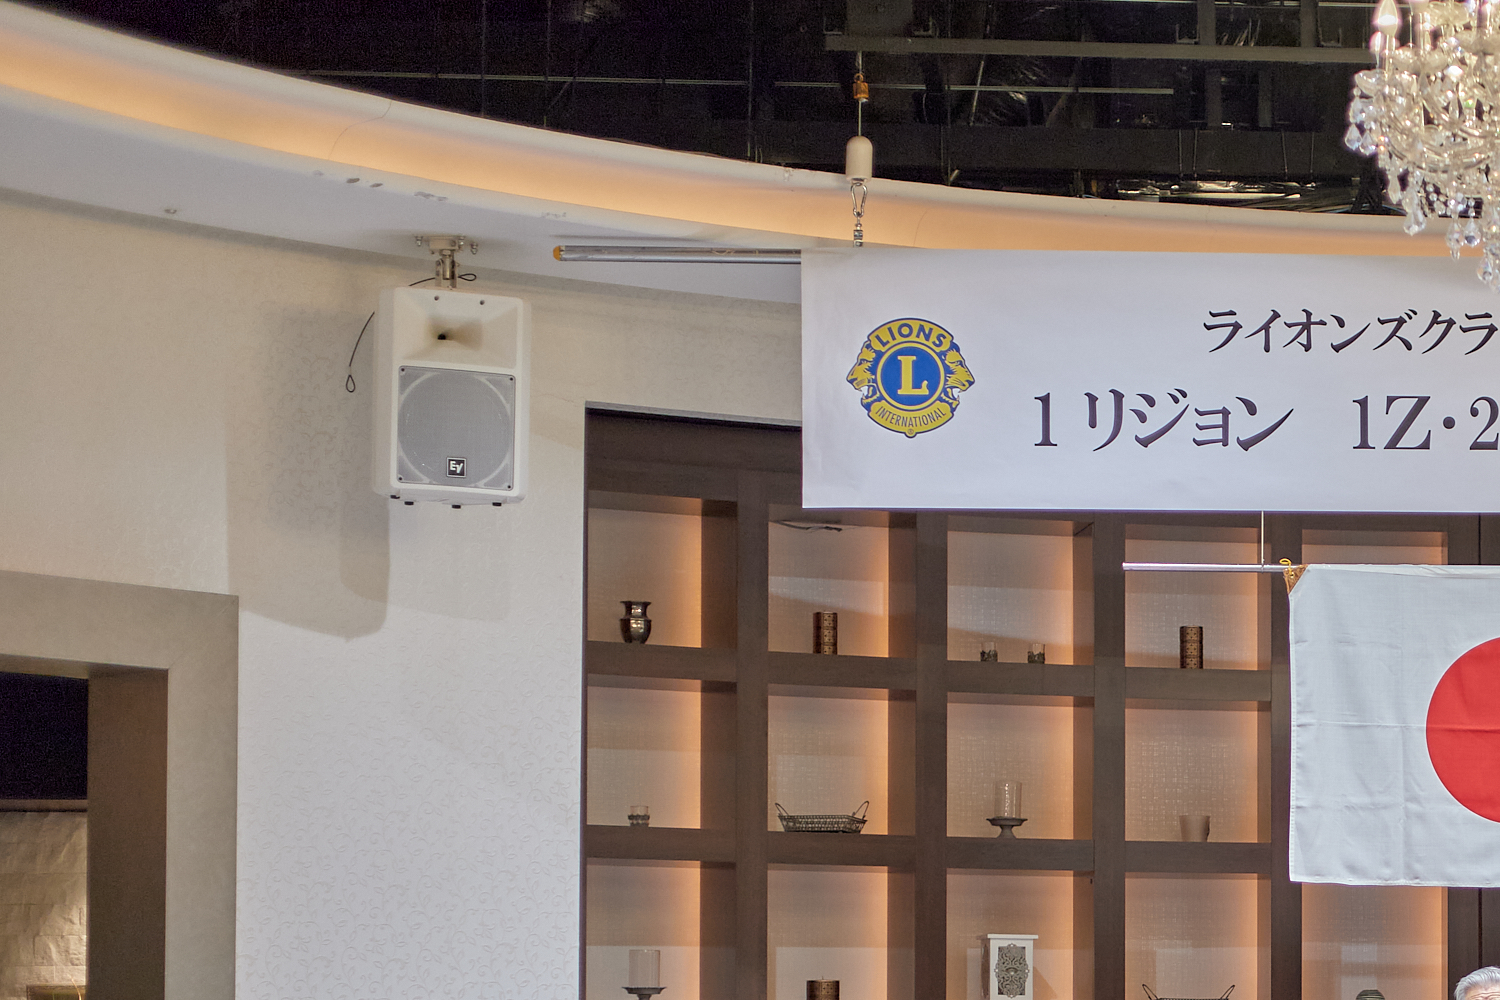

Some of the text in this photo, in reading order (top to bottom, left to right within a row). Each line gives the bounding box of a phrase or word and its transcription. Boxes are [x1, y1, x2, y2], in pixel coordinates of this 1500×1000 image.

[875, 322, 947, 348] LIONS
[897, 355, 929, 395] L
[875, 406, 947, 428] INTERNATIONAL
